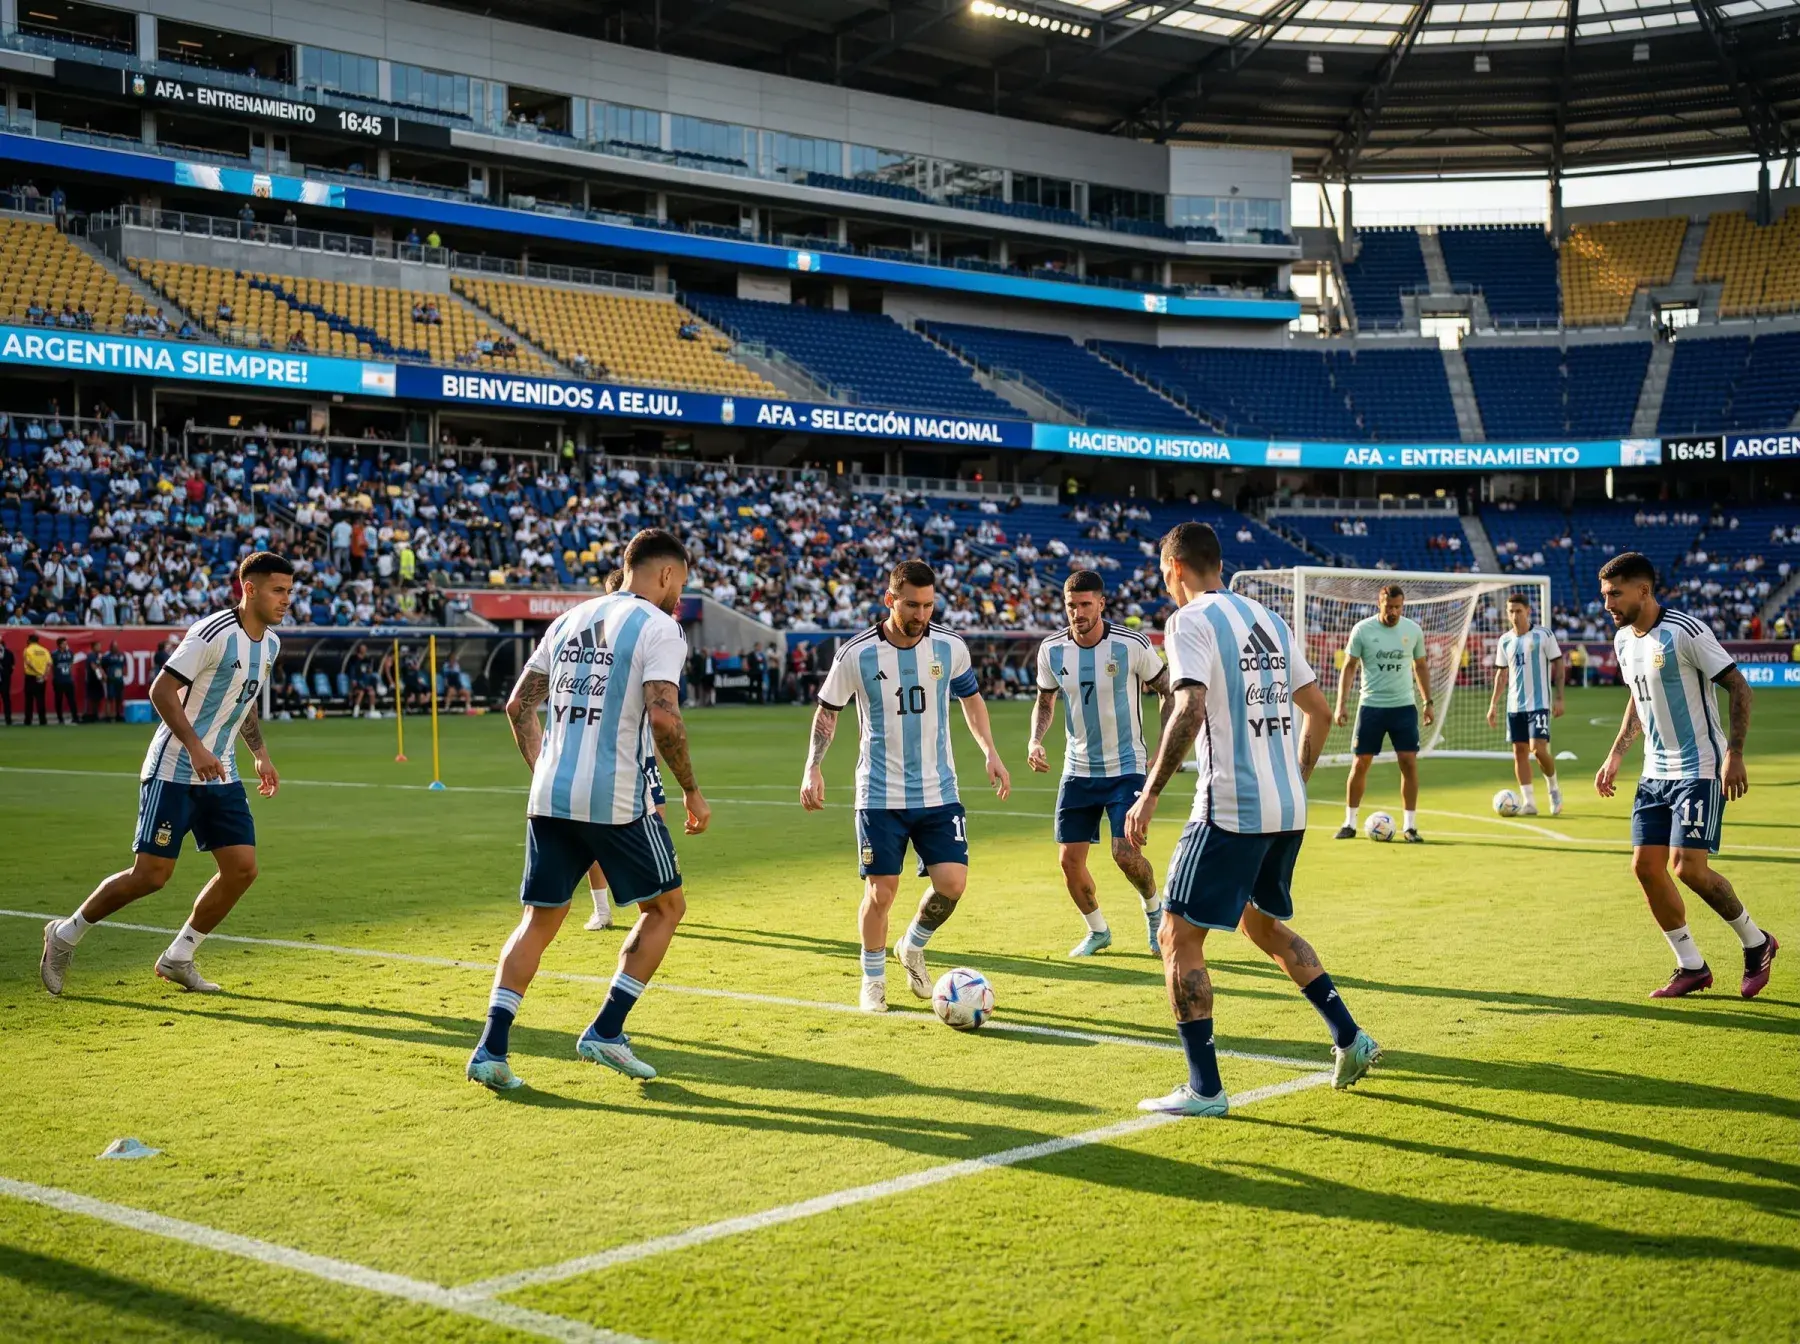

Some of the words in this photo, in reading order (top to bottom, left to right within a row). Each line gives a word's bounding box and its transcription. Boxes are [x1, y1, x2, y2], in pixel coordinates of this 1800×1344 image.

[155, 80, 184, 100] AFA
[197, 88, 316, 123] ENTRENAMIENTO
[339, 111, 382, 135] 16:45
[1, 333, 175, 372] ARGENTINA
[182, 351, 308, 383] SIEMPRE!
[442, 375, 594, 409] BIENVENIDOS
[598, 390, 614, 411] A
[619, 392, 683, 416] EE.UU.
[757, 404, 796, 426] AFA
[811, 408, 910, 436] SELECCIÓN
[914, 418, 1003, 443] NACIONAL
[1068, 431, 1151, 455] HACIENDO
[1155, 439, 1231, 460] HISTORIA
[1344, 448, 1384, 466] AFA
[1401, 447, 1580, 467] ENTRENAMIENTO
[1668, 441, 1716, 461] 16:45
[559, 646, 614, 666] adidas
[1377, 663, 1403, 672] YPF
[236, 679, 259, 704] 19
[895, 685, 926, 715] 10
[1081, 681, 1094, 705] 7
[1634, 674, 1652, 702] 11
[554, 705, 603, 726] YPF
[1535, 714, 1549, 728] 11
[1681, 798, 1705, 827] 11
